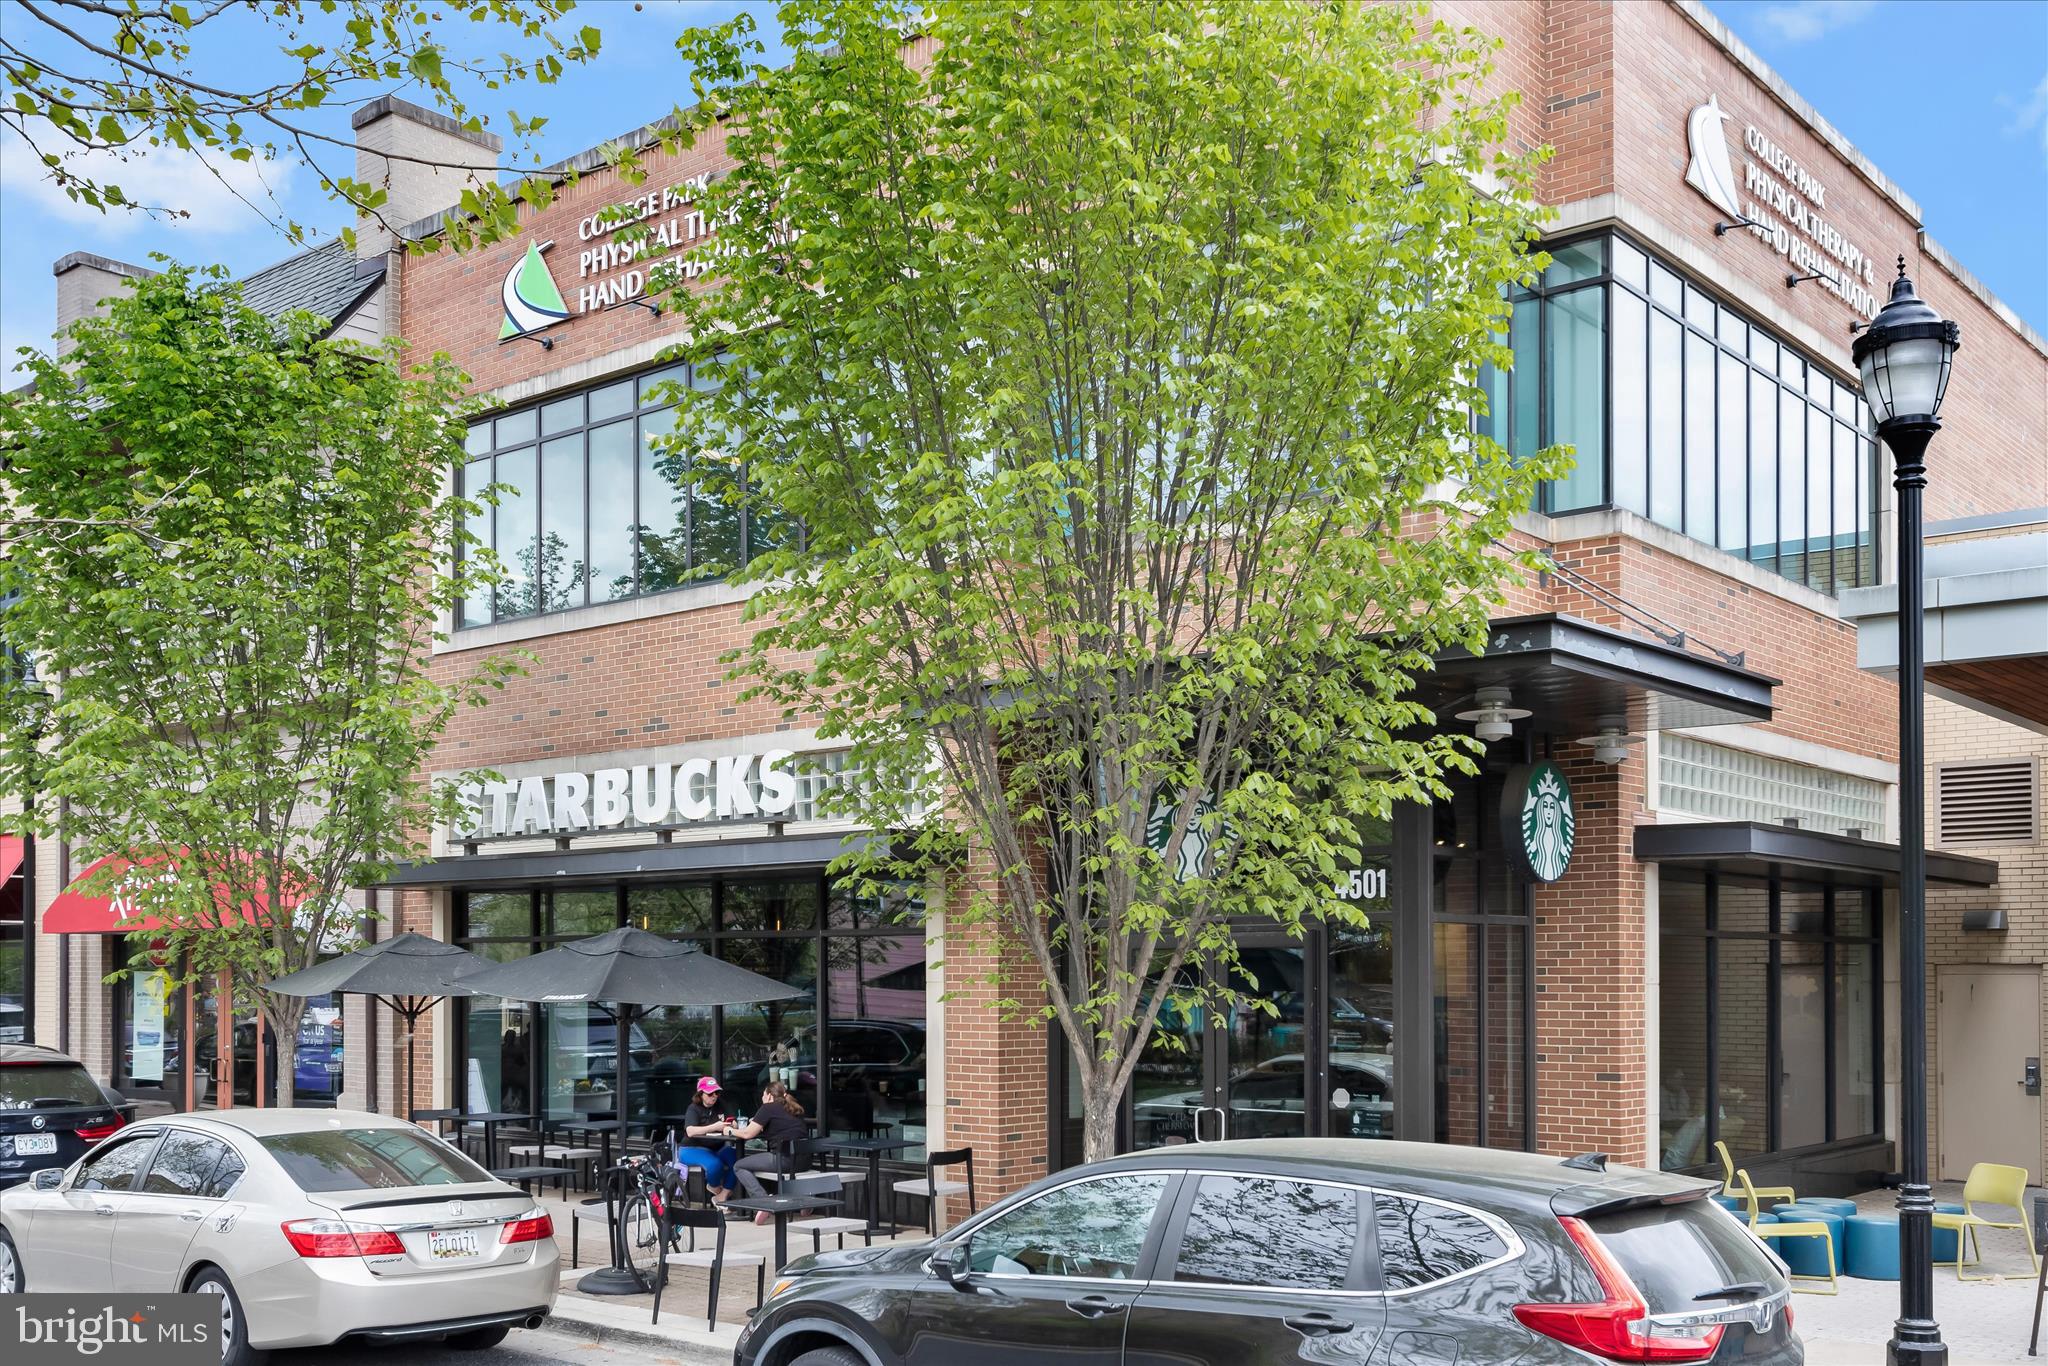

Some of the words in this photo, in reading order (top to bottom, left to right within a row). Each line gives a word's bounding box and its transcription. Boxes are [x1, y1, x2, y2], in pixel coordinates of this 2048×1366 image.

[1745, 125, 1797, 186] COLLEGE
[1799, 167, 1826, 210] PARK
[1745, 160, 1811, 235] PHYSICAL
[1811, 212, 1863, 276] THERAPY
[1863, 258, 1874, 286] &
[1746, 200, 1789, 255] HAND
[579, 270, 644, 314] HAND
[451, 748, 796, 838] STARBUCKS
[1334, 868, 1387, 900] 4501
[315, 1025, 325, 1036] US
